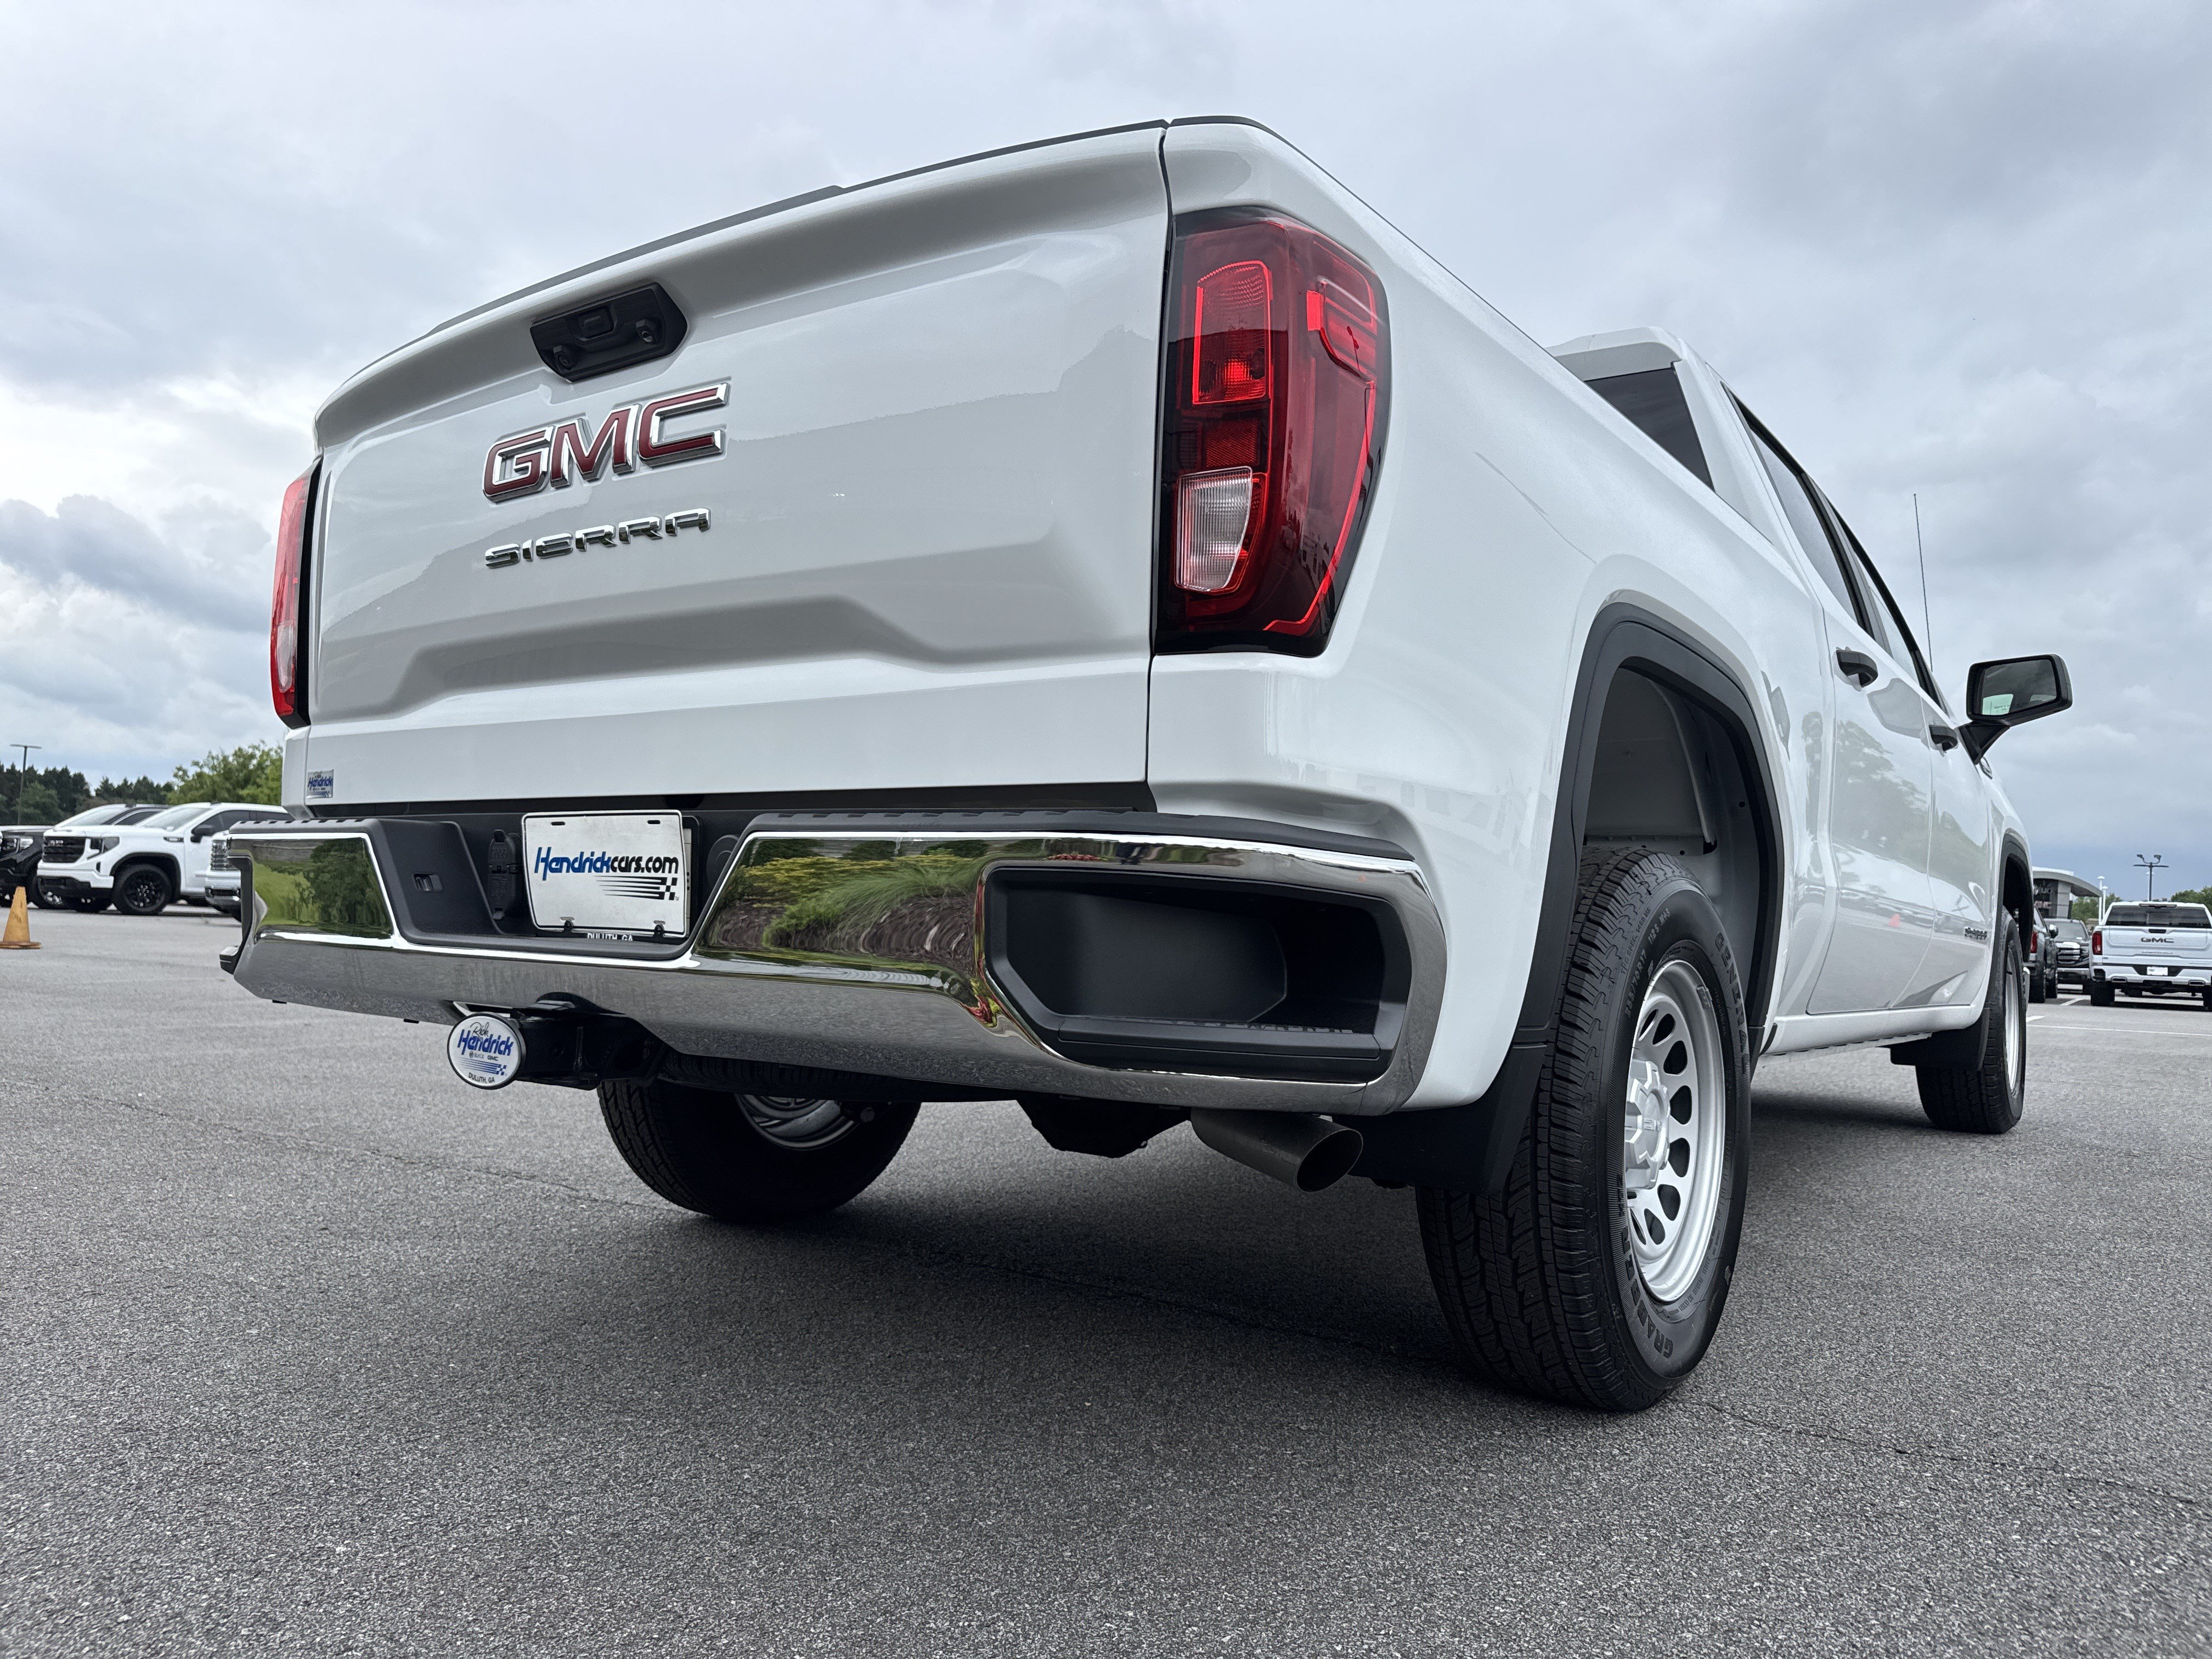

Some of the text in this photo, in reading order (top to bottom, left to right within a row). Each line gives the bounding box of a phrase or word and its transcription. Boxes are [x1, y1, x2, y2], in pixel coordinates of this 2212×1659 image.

[483, 383, 730, 504] GMC
[485, 507, 711, 569] SIERRA
[534, 847, 679, 881] Hendrickcars.com
[457, 1029, 514, 1056] Hendrick
[468, 1072, 488, 1084] DULUTH,
